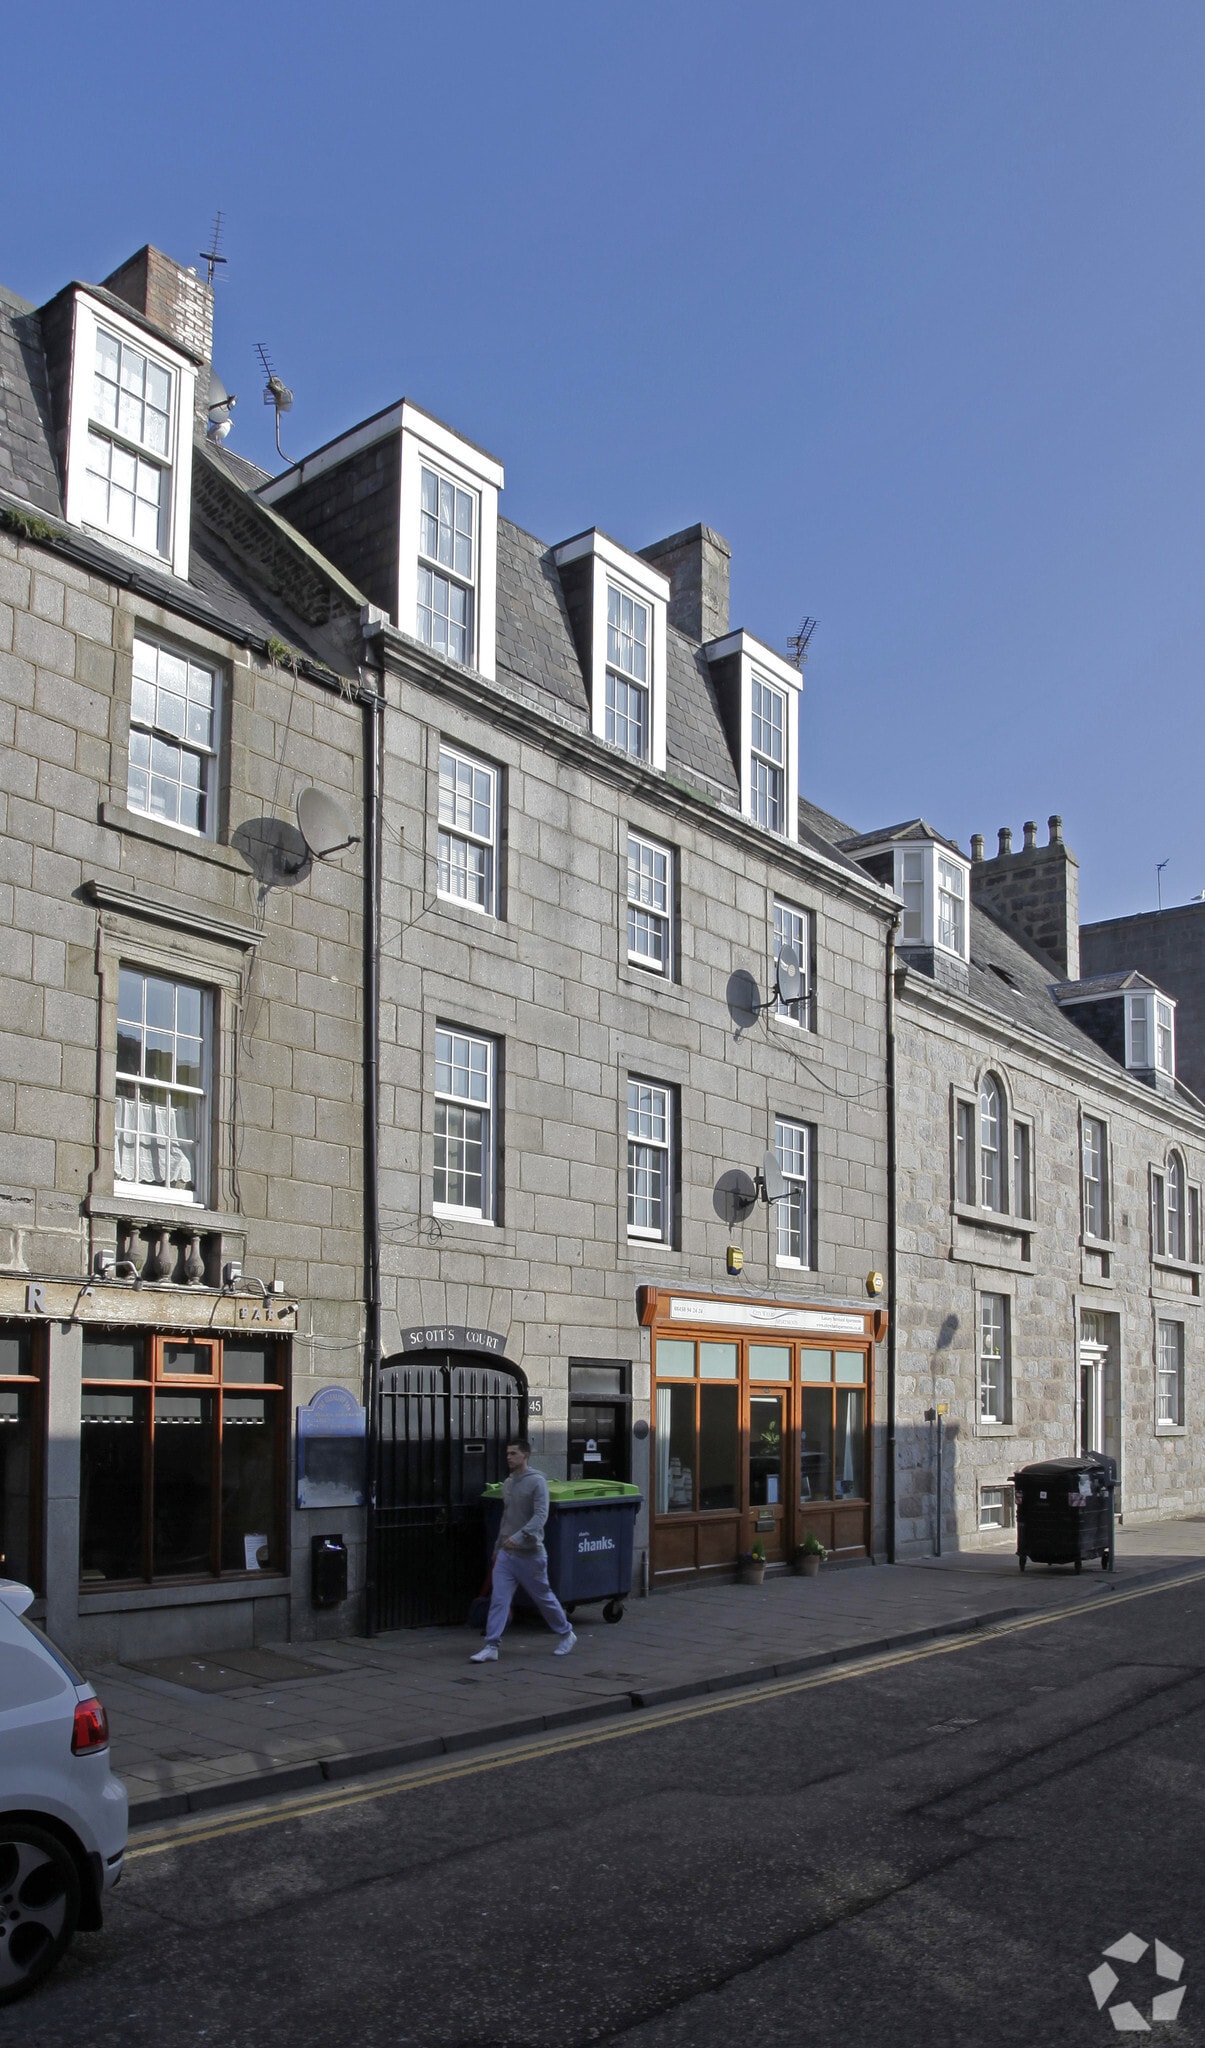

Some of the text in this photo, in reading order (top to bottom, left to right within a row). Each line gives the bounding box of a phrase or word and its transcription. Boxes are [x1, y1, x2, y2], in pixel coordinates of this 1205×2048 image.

[239, 1306, 276, 1321] BAR
[410, 1327, 499, 1349] SCOTT'S COURT
[529, 1400, 541, 1412] 45
